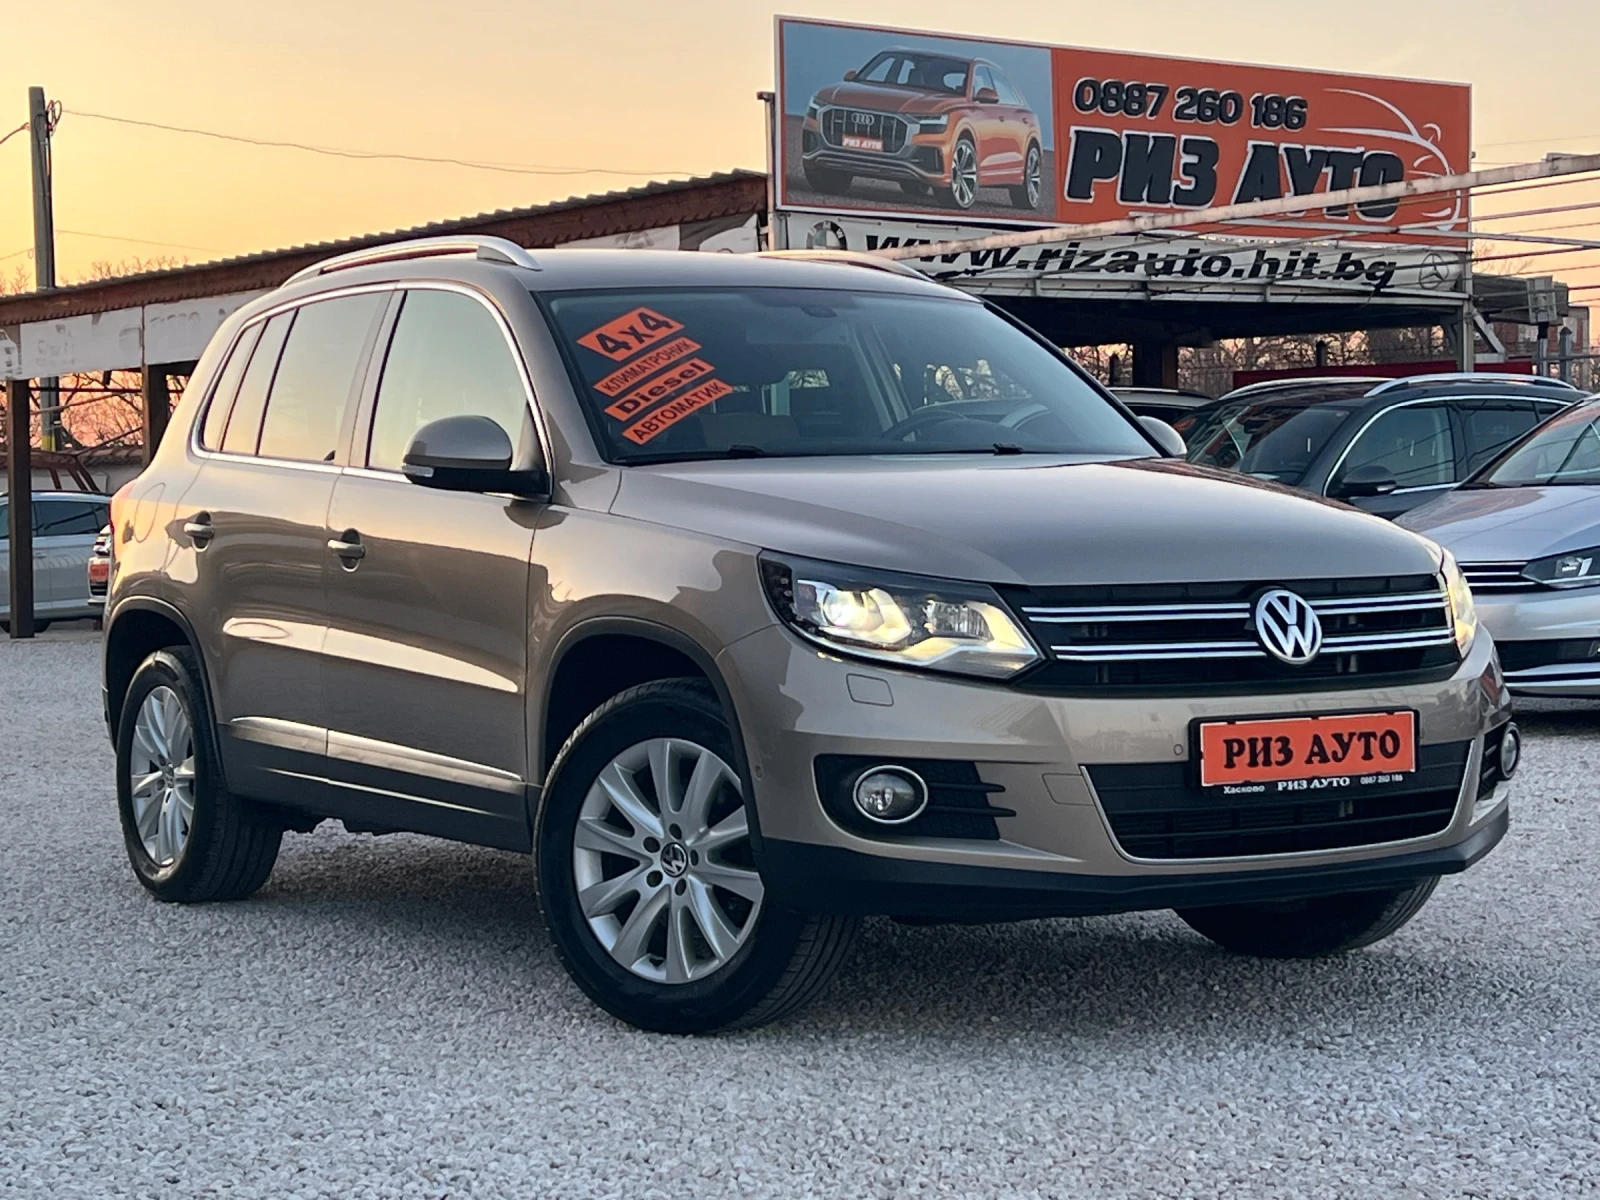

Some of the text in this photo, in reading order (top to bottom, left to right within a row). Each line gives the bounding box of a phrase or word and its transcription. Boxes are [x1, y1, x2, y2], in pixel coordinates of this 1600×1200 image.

[1074, 77, 1308, 131] 0887 260 186
[1065, 126, 1405, 223] РИЗ АУТО
[596, 311, 674, 354] 4x4
[601, 341, 694, 393] КЛИМАТРОНИК
[615, 362, 707, 414] Diesel
[632, 381, 726, 441] АВТОМАТИК
[1223, 729, 1401, 769] РИЗ АУТО
[1277, 779, 1308, 791] РИЗ
[1310, 777, 1350, 789] АУТО
